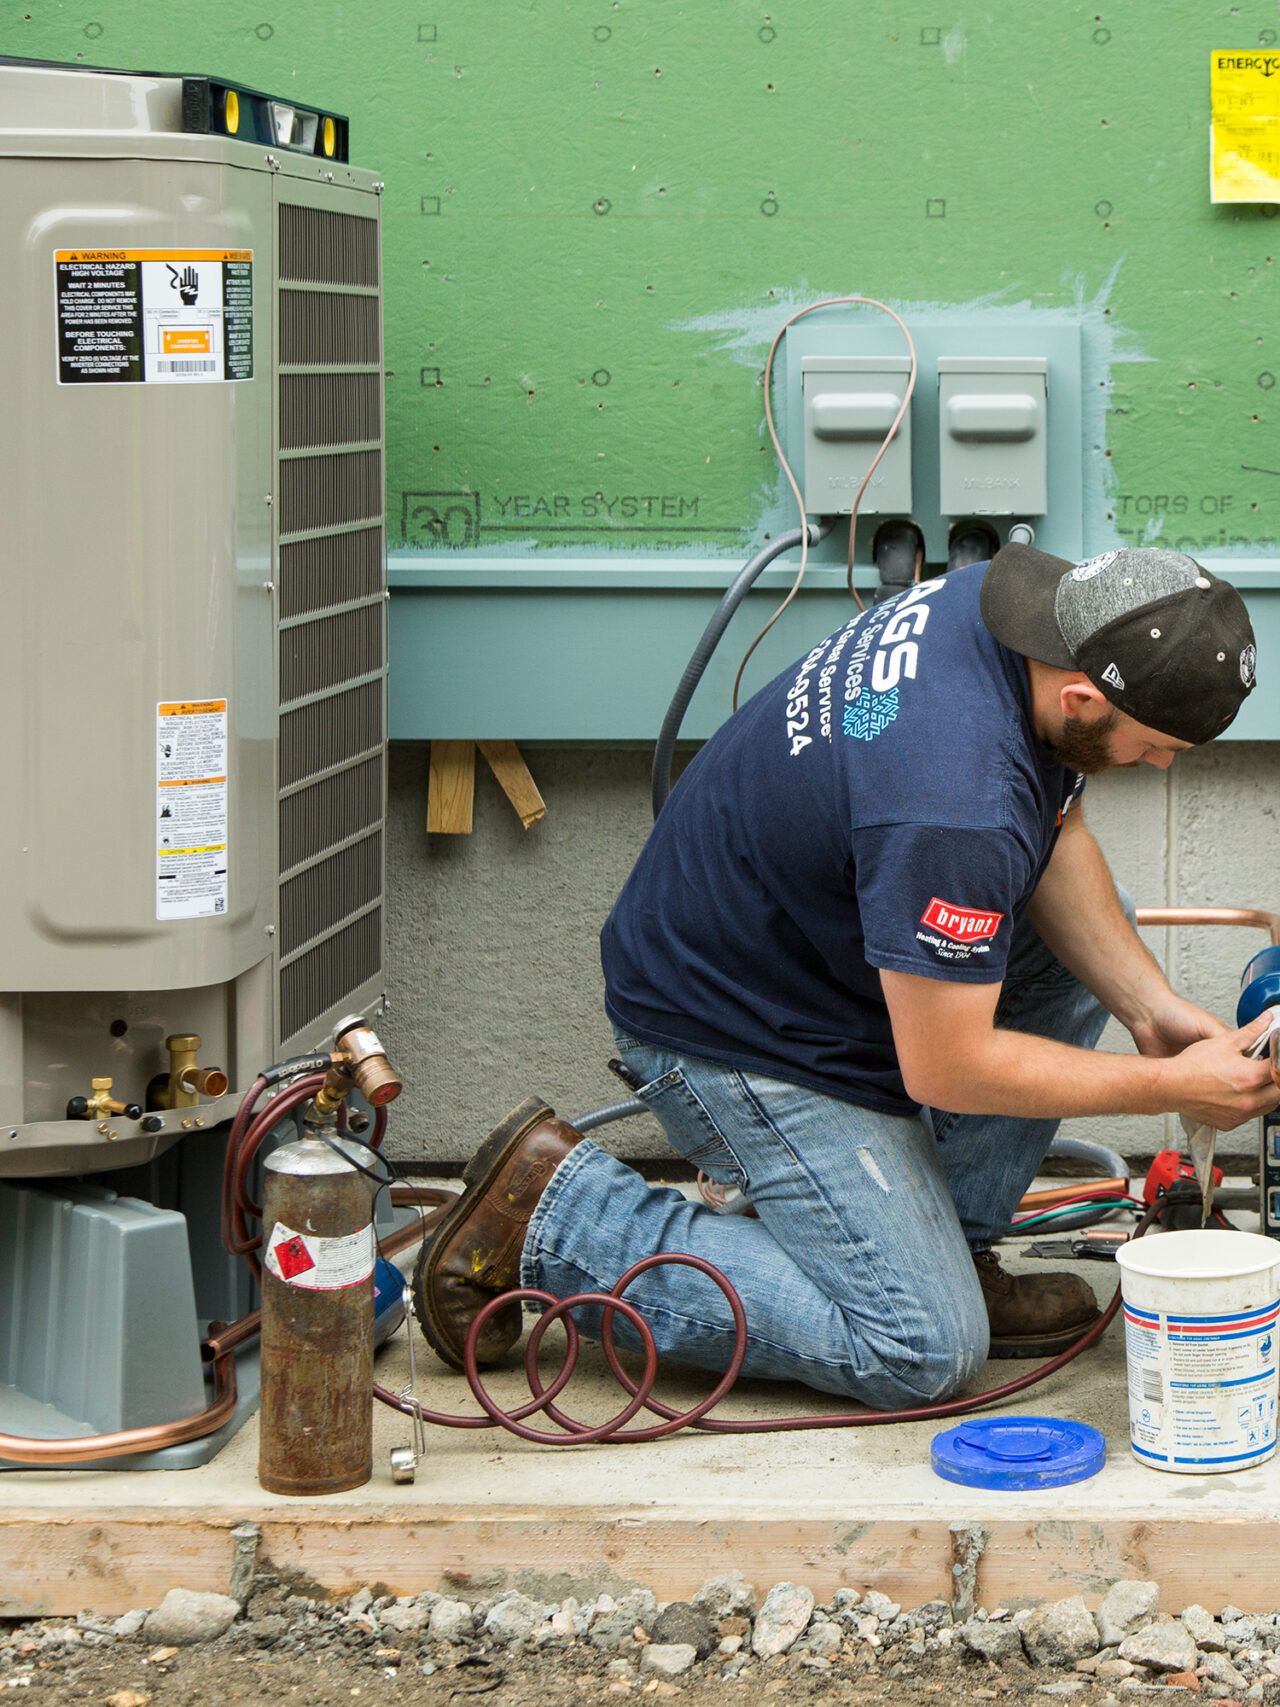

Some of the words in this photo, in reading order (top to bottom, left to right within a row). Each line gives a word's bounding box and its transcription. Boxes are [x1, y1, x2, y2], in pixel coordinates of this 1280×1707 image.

[81, 252, 126, 260] WARNING
[827, 476, 886, 489] MILBNK
[493, 495, 570, 519] YEAR
[580, 495, 700, 519] SYSTEM
[1199, 495, 1233, 514] OF
[871, 578, 947, 692] AGS
[845, 623, 884, 701] Services
[937, 907, 993, 935] bryant
[916, 932, 941, 948] Heating
[948, 942, 972, 952] Cooling
[936, 948, 954, 959] Since
